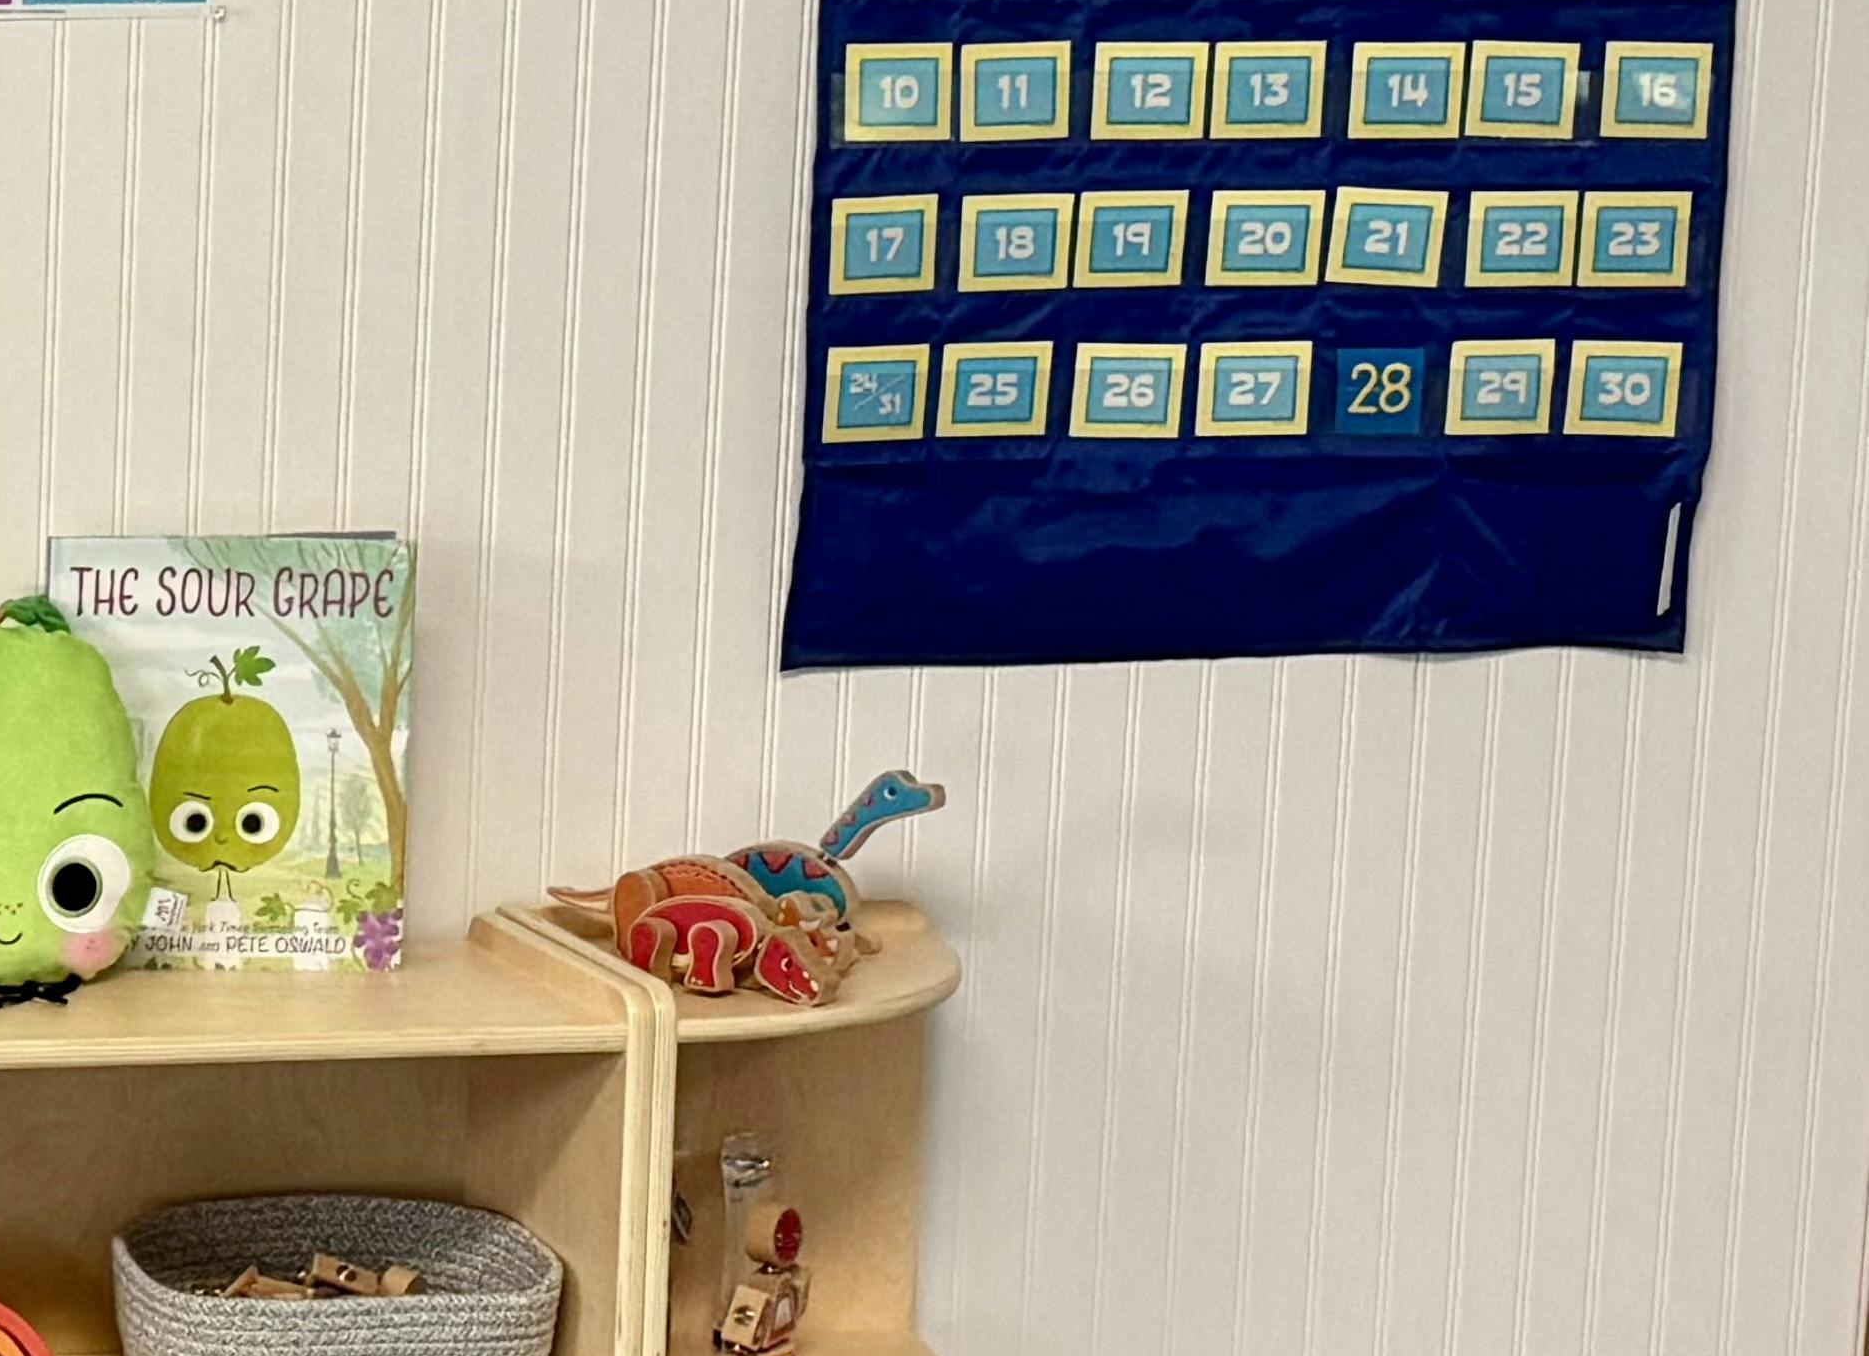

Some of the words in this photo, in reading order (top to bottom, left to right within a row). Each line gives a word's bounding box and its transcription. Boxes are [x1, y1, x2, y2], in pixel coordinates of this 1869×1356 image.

[880, 76, 919, 110] 10
[998, 75, 1029, 109] 11
[1131, 74, 1172, 109] 12
[1250, 73, 1291, 107] 13
[1388, 74, 1429, 107] 14
[1504, 73, 1543, 106] 15
[1638, 73, 1677, 107] 16
[866, 227, 905, 262] 17
[996, 226, 1035, 260] 18
[1113, 222, 1152, 256] 19
[1238, 222, 1292, 255] 20
[1364, 221, 1408, 256] 21
[1495, 222, 1549, 256] 22
[1607, 222, 1660, 256] 23
[967, 373, 1018, 407] 25
[1103, 374, 1155, 407] 26
[1228, 372, 1282, 405] 27
[1348, 362, 1412, 414] 28
[1477, 371, 1527, 405] 29
[1598, 372, 1651, 405] 30
[69, 566, 140, 618] THE
[156, 566, 256, 619] SOUR
[272, 567, 395, 620] GRAPE
[144, 935, 193, 952] JOHN
[226, 935, 269, 953] PETE
[274, 935, 346, 954] OSWALD
